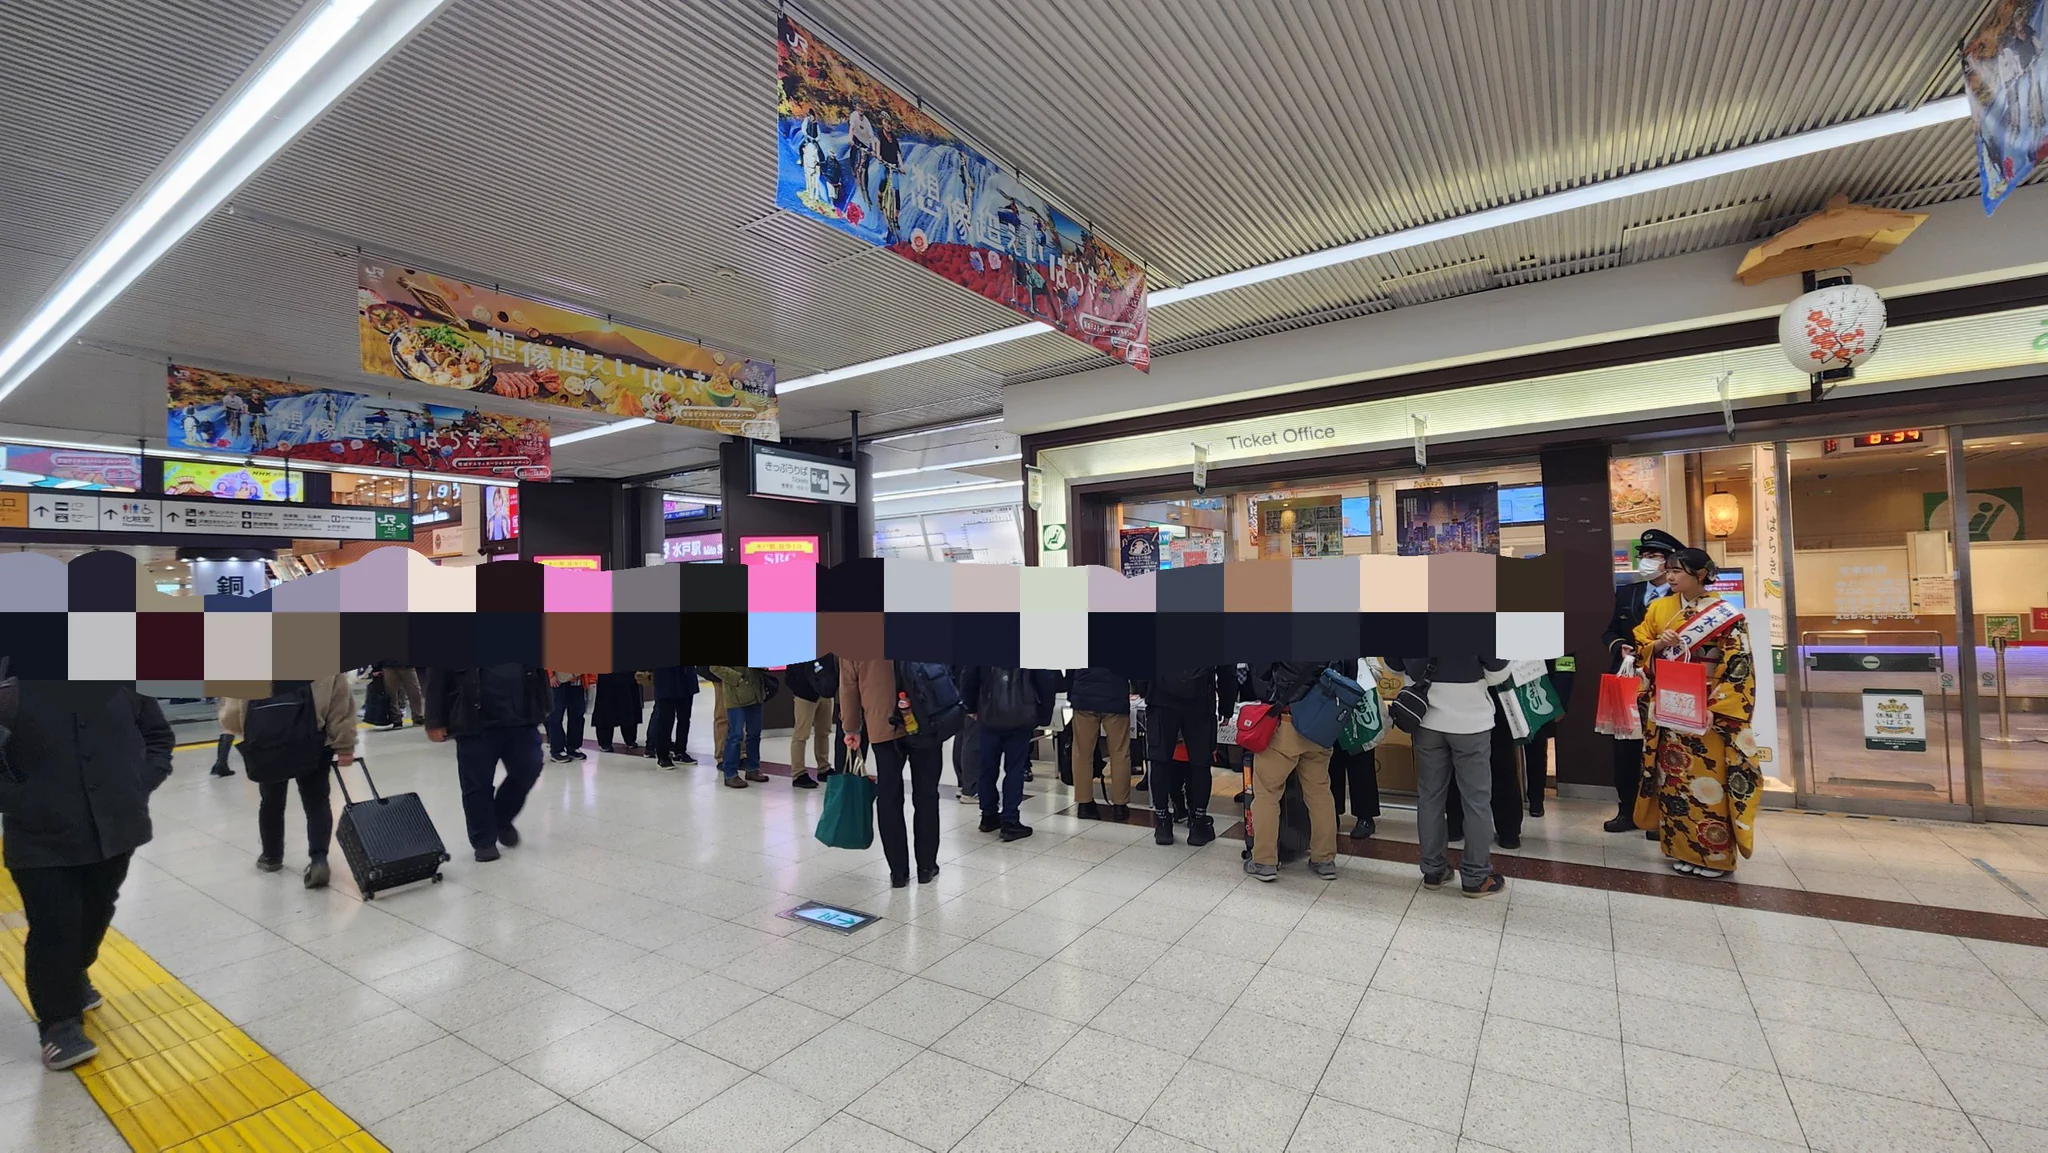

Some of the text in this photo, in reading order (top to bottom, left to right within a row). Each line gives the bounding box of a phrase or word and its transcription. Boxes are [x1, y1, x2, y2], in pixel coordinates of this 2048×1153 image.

[786, 32, 808, 54] JR
[365, 266, 385, 278] JR
[173, 370, 190, 379] JR
[1226, 426, 1335, 449] Ticket Office
[765, 461, 808, 476] きっぷうりば
[377, 515, 396, 524] JR
[672, 540, 701, 557] 水戸駅
